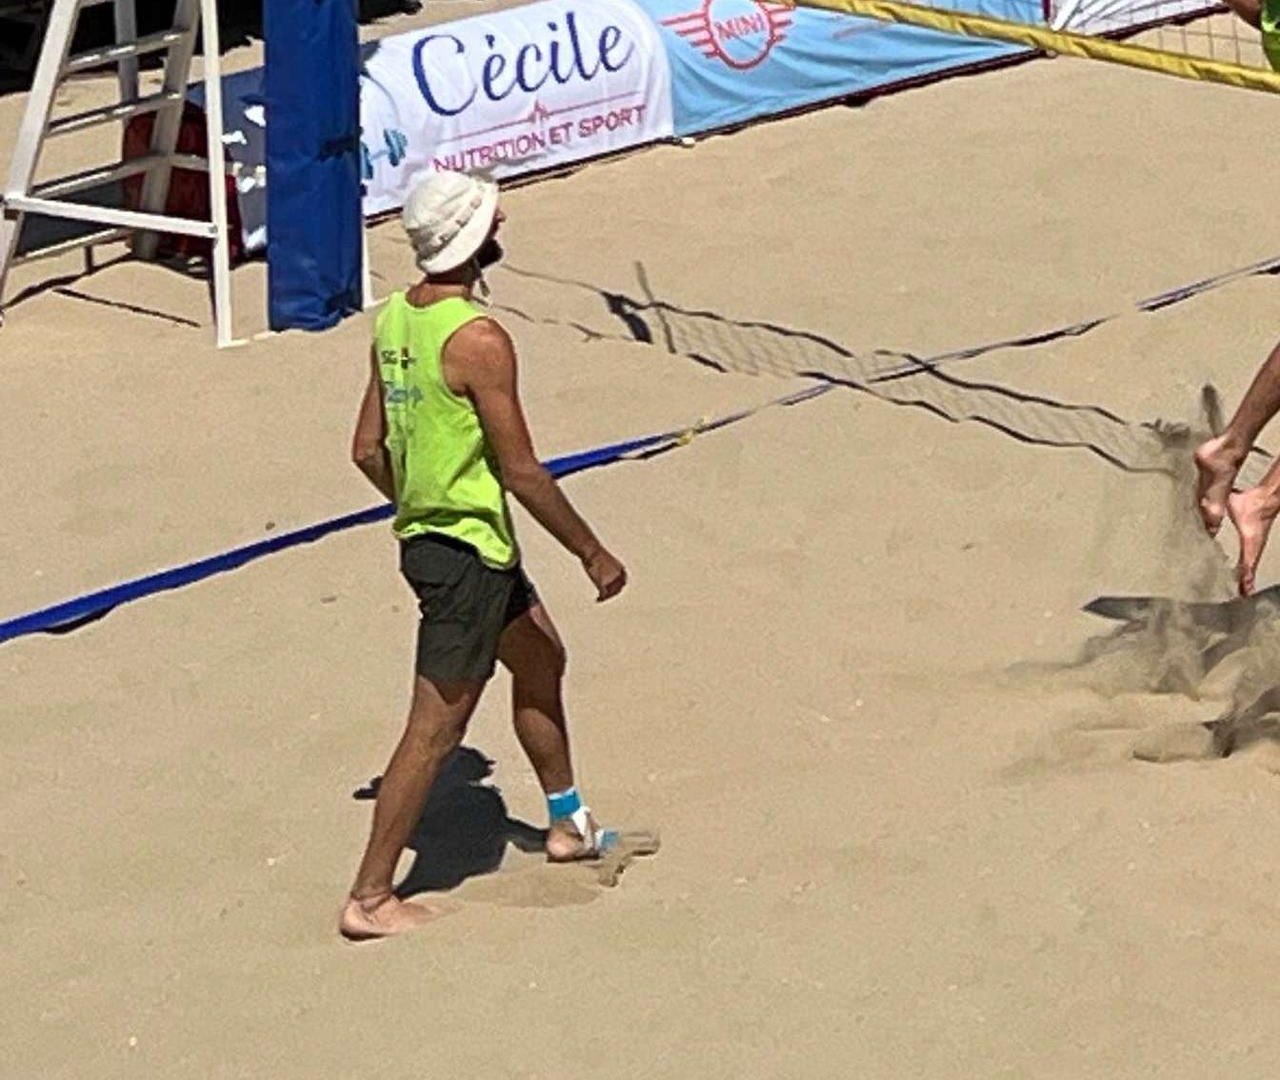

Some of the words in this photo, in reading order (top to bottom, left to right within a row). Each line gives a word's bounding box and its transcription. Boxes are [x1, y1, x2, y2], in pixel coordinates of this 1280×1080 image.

[411, 11, 636, 117] Cécile
[433, 129, 546, 173] NUTRITION
[549, 120, 575, 146] ET
[578, 103, 648, 140] SPORT
